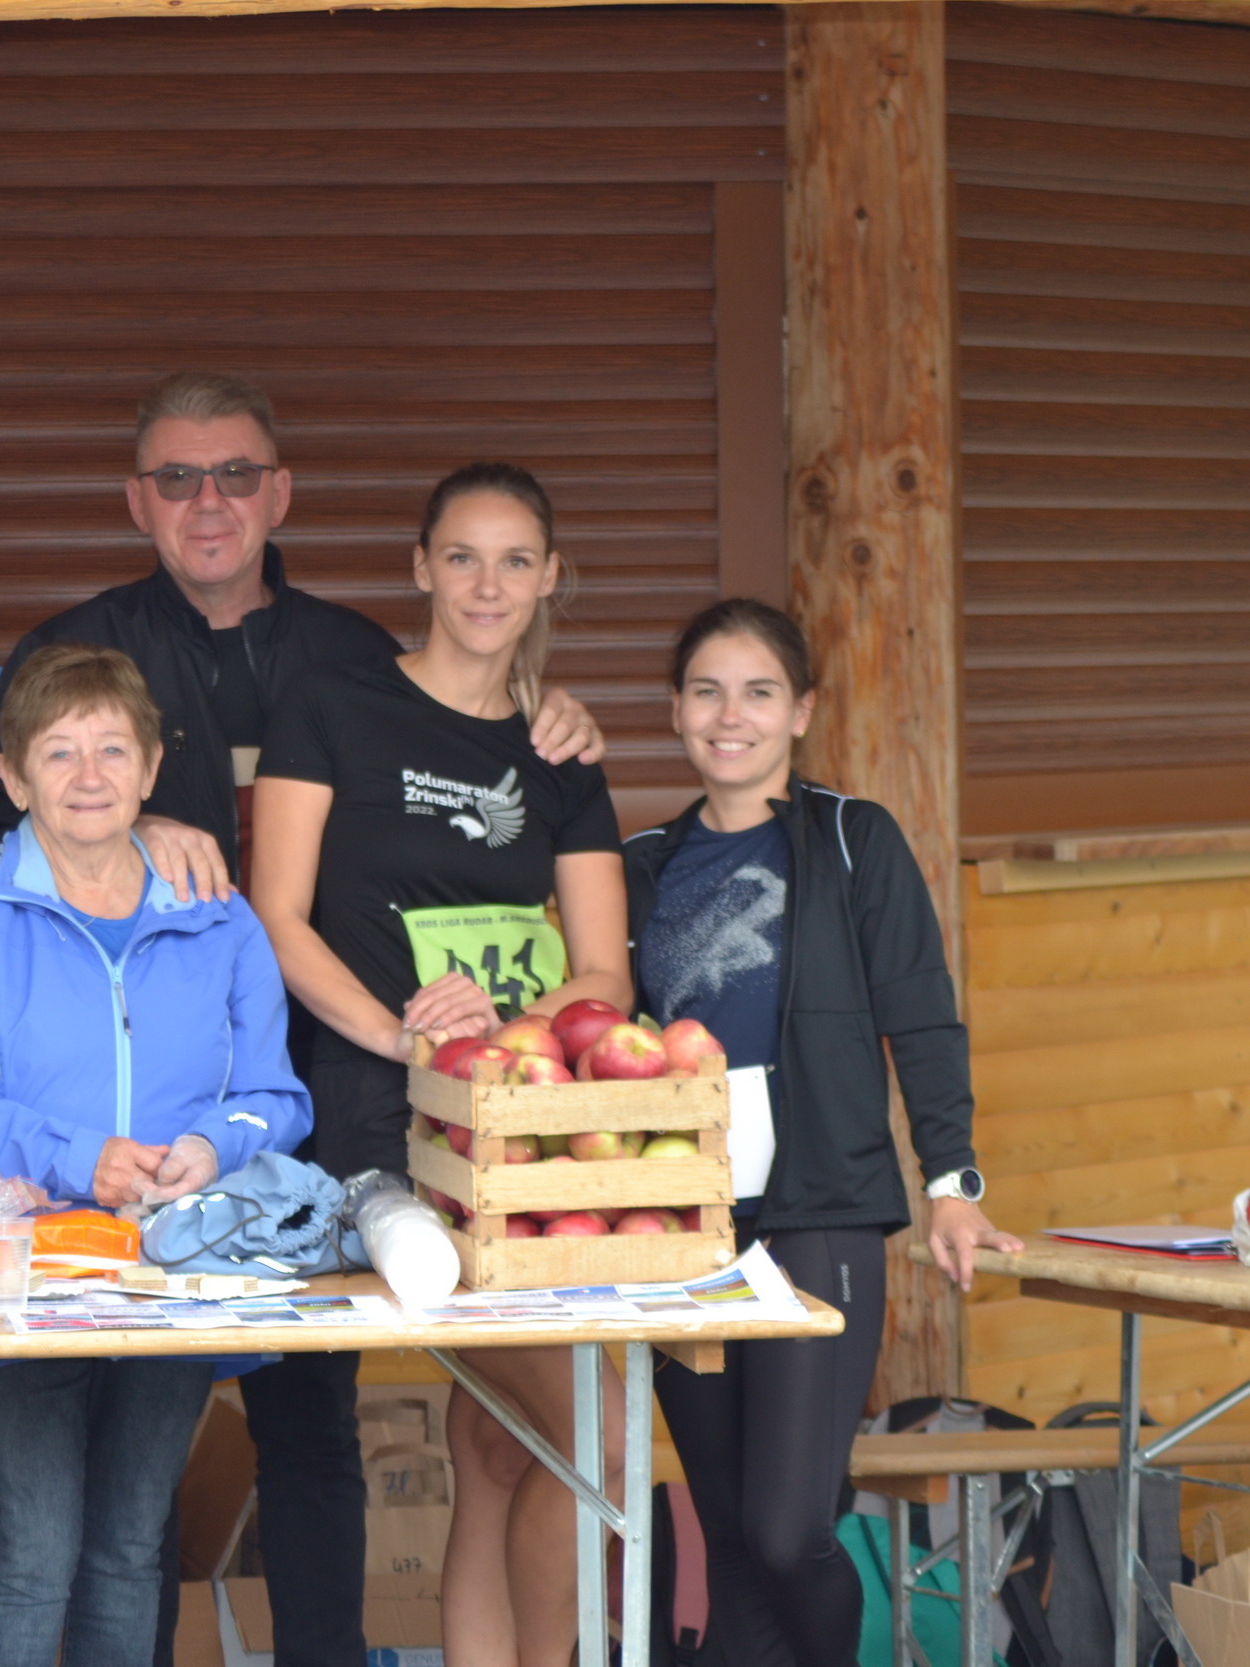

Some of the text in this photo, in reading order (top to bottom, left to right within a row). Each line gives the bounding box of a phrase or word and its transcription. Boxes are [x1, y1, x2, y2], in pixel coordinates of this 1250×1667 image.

[402, 769, 509, 805] Polumaraton
[405, 805, 437, 816] 2022.
[440, 918, 462, 928] LIGA
[463, 916, 493, 926] RUDAR
[393, 1556, 422, 1574] 477
